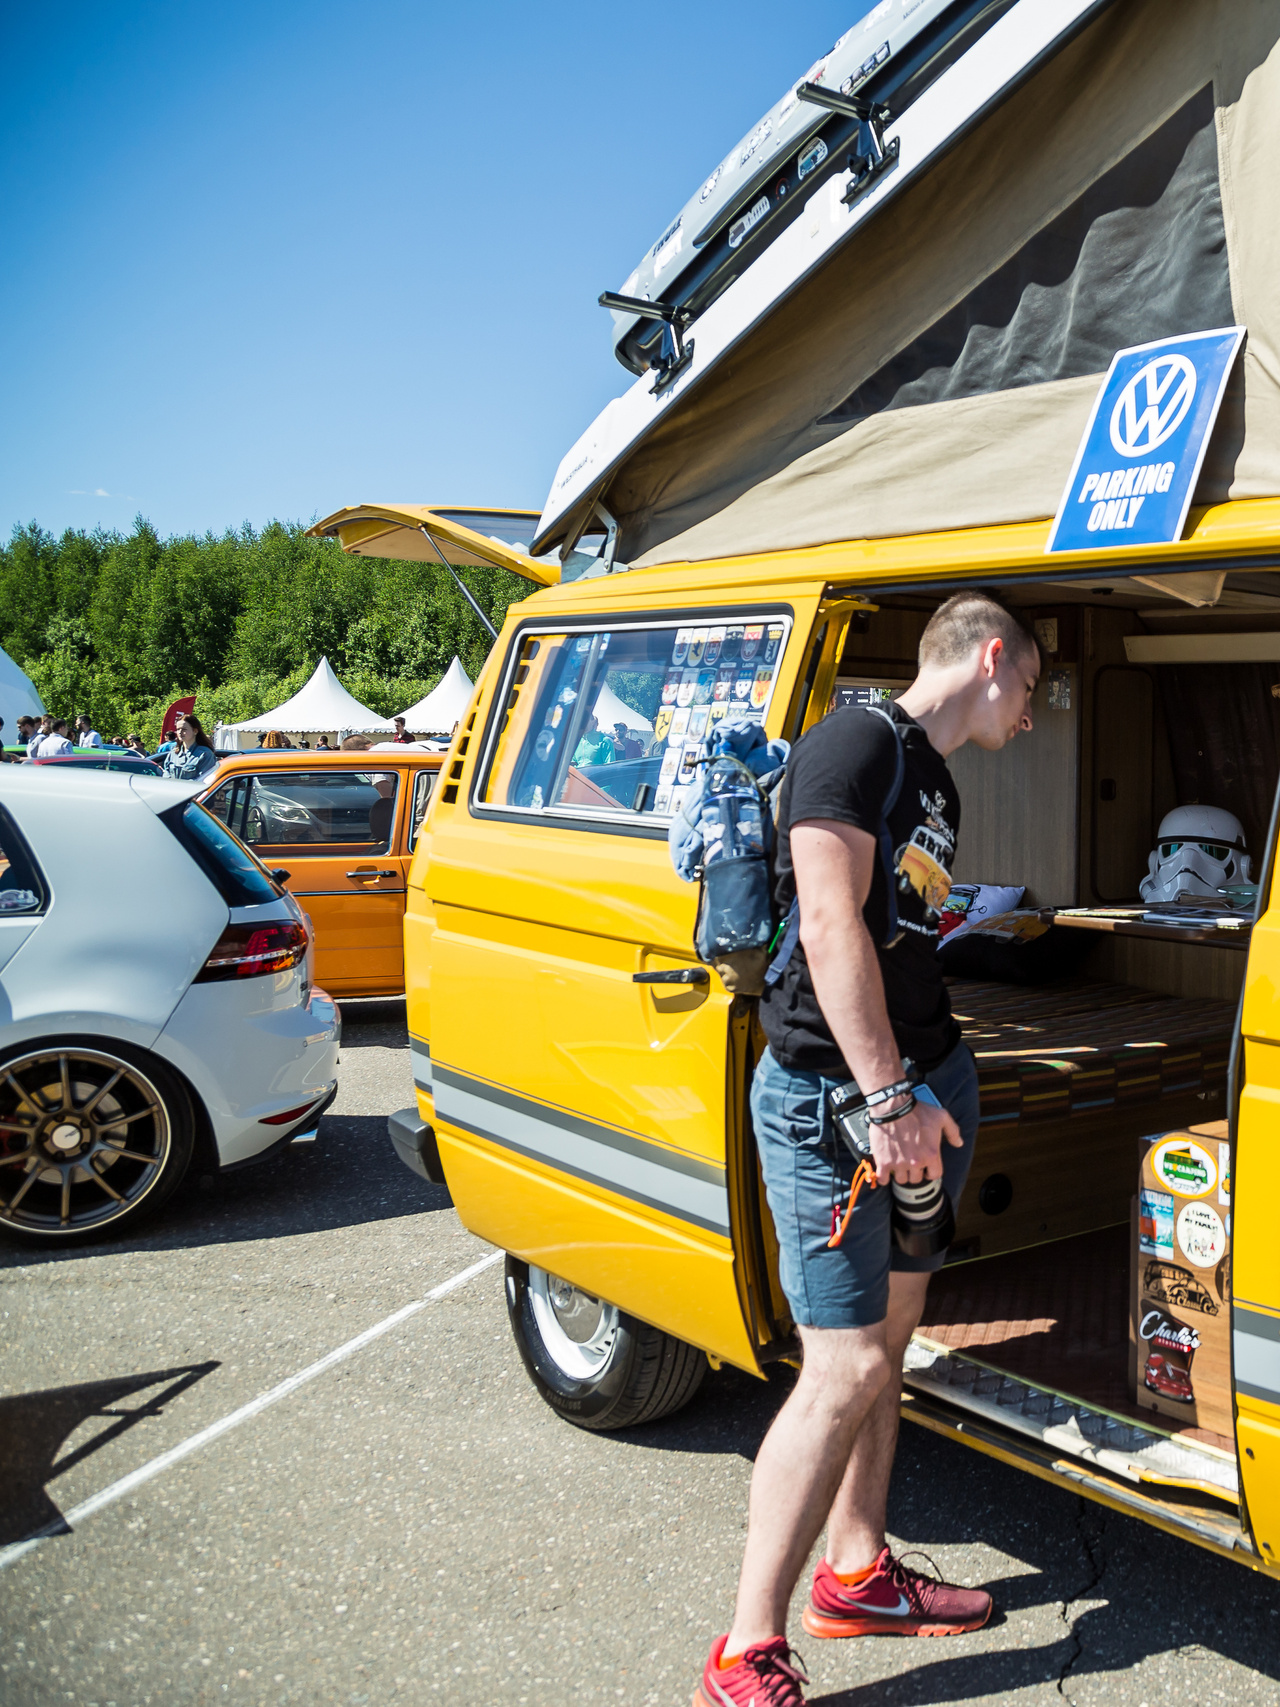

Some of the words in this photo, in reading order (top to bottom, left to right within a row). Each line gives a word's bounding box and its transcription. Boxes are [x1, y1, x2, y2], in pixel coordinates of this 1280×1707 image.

[1077, 461, 1176, 503] PARKING
[1086, 496, 1145, 532] ONLY
[1139, 1310, 1202, 1349] Charlie's
